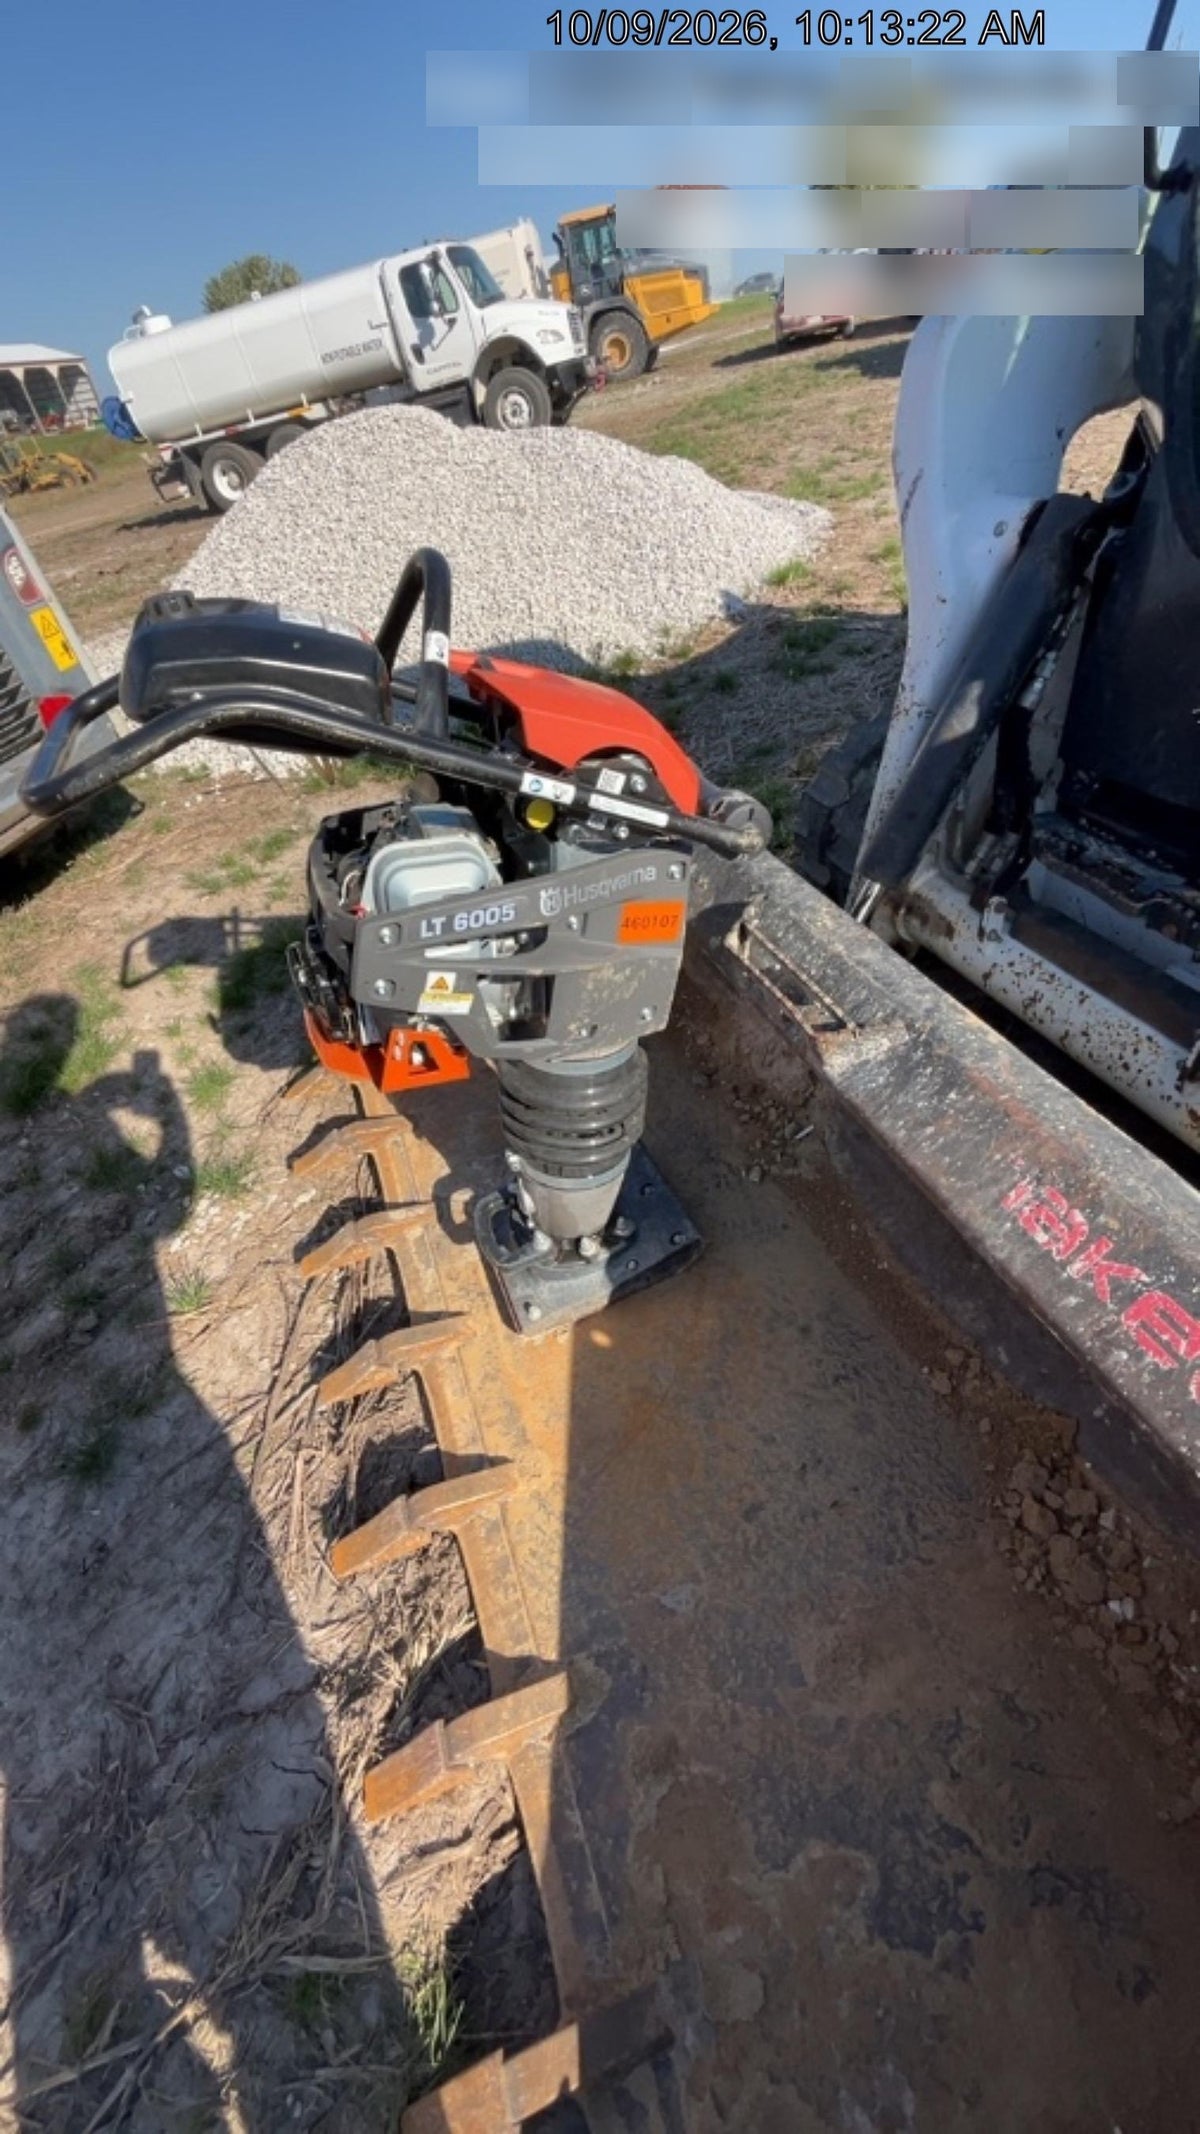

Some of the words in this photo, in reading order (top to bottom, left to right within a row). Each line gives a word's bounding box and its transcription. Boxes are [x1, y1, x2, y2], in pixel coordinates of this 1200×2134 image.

[564, 864, 657, 908] Husqvarna
[420, 917, 447, 938] LT
[453, 903, 516, 931] 6005
[1003, 1158, 1200, 1404] ake
